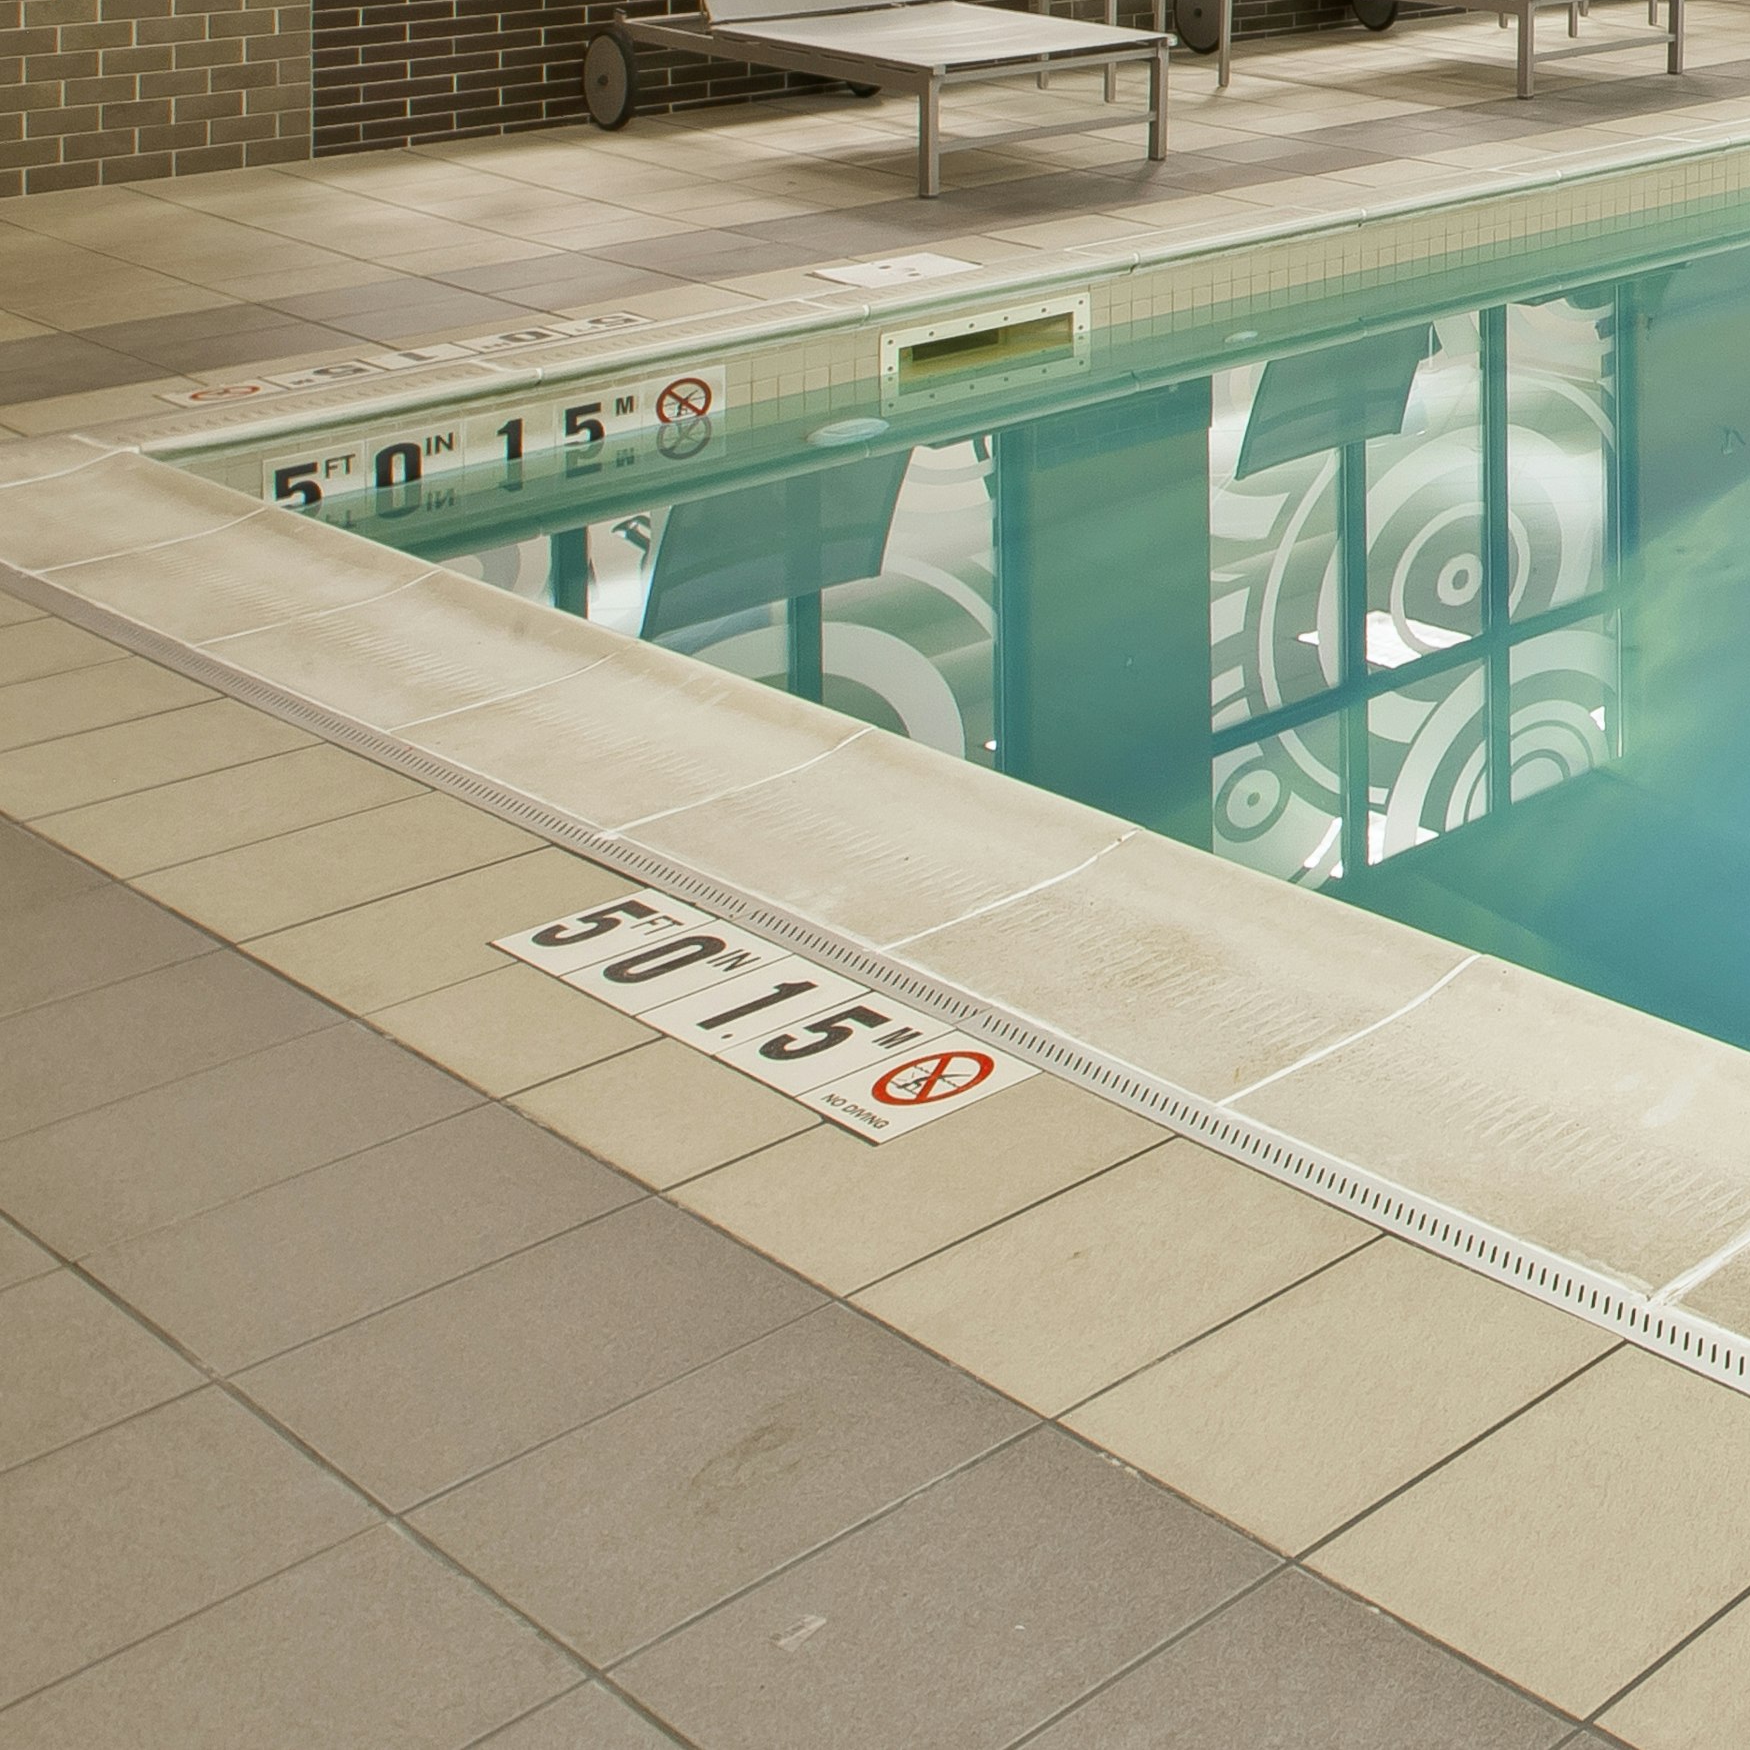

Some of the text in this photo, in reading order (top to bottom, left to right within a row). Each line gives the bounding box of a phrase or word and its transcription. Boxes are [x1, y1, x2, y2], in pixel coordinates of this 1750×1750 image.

[274, 462, 322, 509] 5
[325, 454, 356, 479] FT
[426, 432, 454, 457] IN
[614, 395, 635, 417] M
[531, 899, 659, 947] 5
[629, 914, 685, 937] FT
[602, 935, 727, 984] 0
[705, 948, 762, 973] IN
[871, 1016, 924, 1050] M
[821, 1093, 890, 1130] NO DIVING
